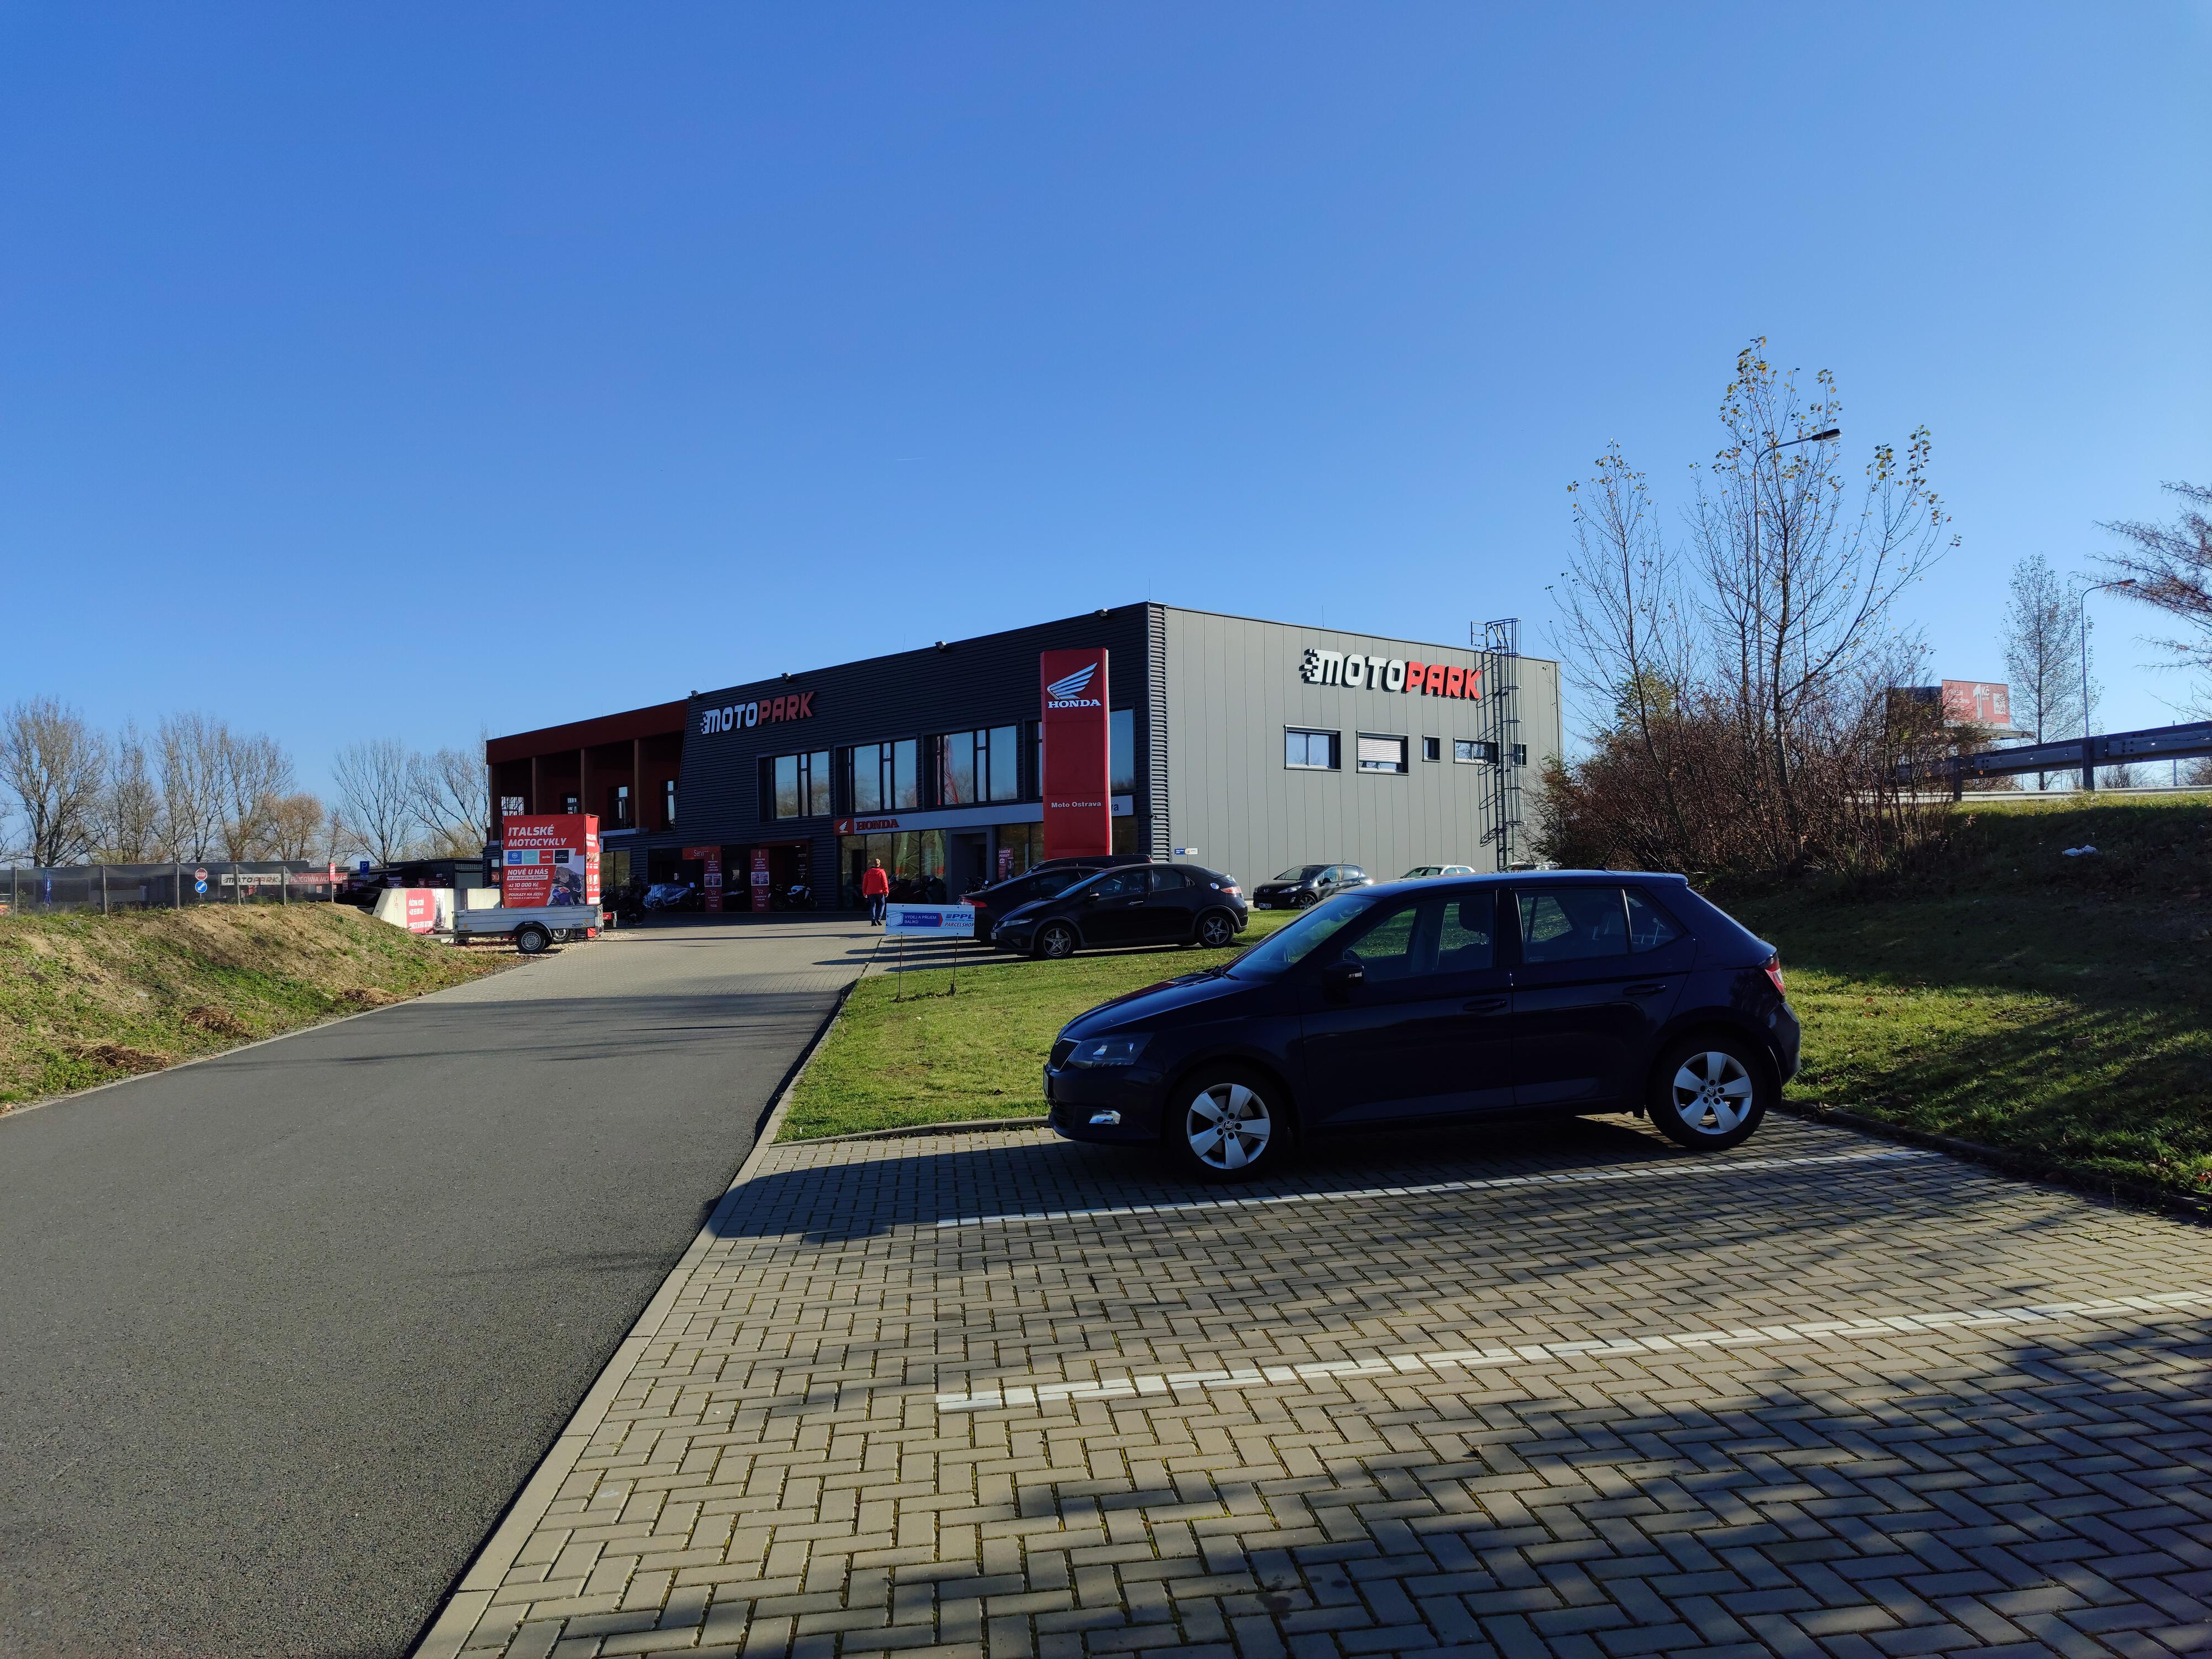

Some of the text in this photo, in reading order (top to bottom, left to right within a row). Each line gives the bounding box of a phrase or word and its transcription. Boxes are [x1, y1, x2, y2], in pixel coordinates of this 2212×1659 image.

[1300, 649, 1483, 700] MOTOPARK
[1048, 699, 1102, 708] HONDA
[1973, 684, 1981, 719] 1
[1981, 686, 1990, 696] Kč
[700, 691, 814, 734] MOTOPARK
[508, 825, 555, 836] ITALSKÉ
[855, 818, 899, 831] HONDA
[508, 838, 567, 847] MOTOCYKLY
